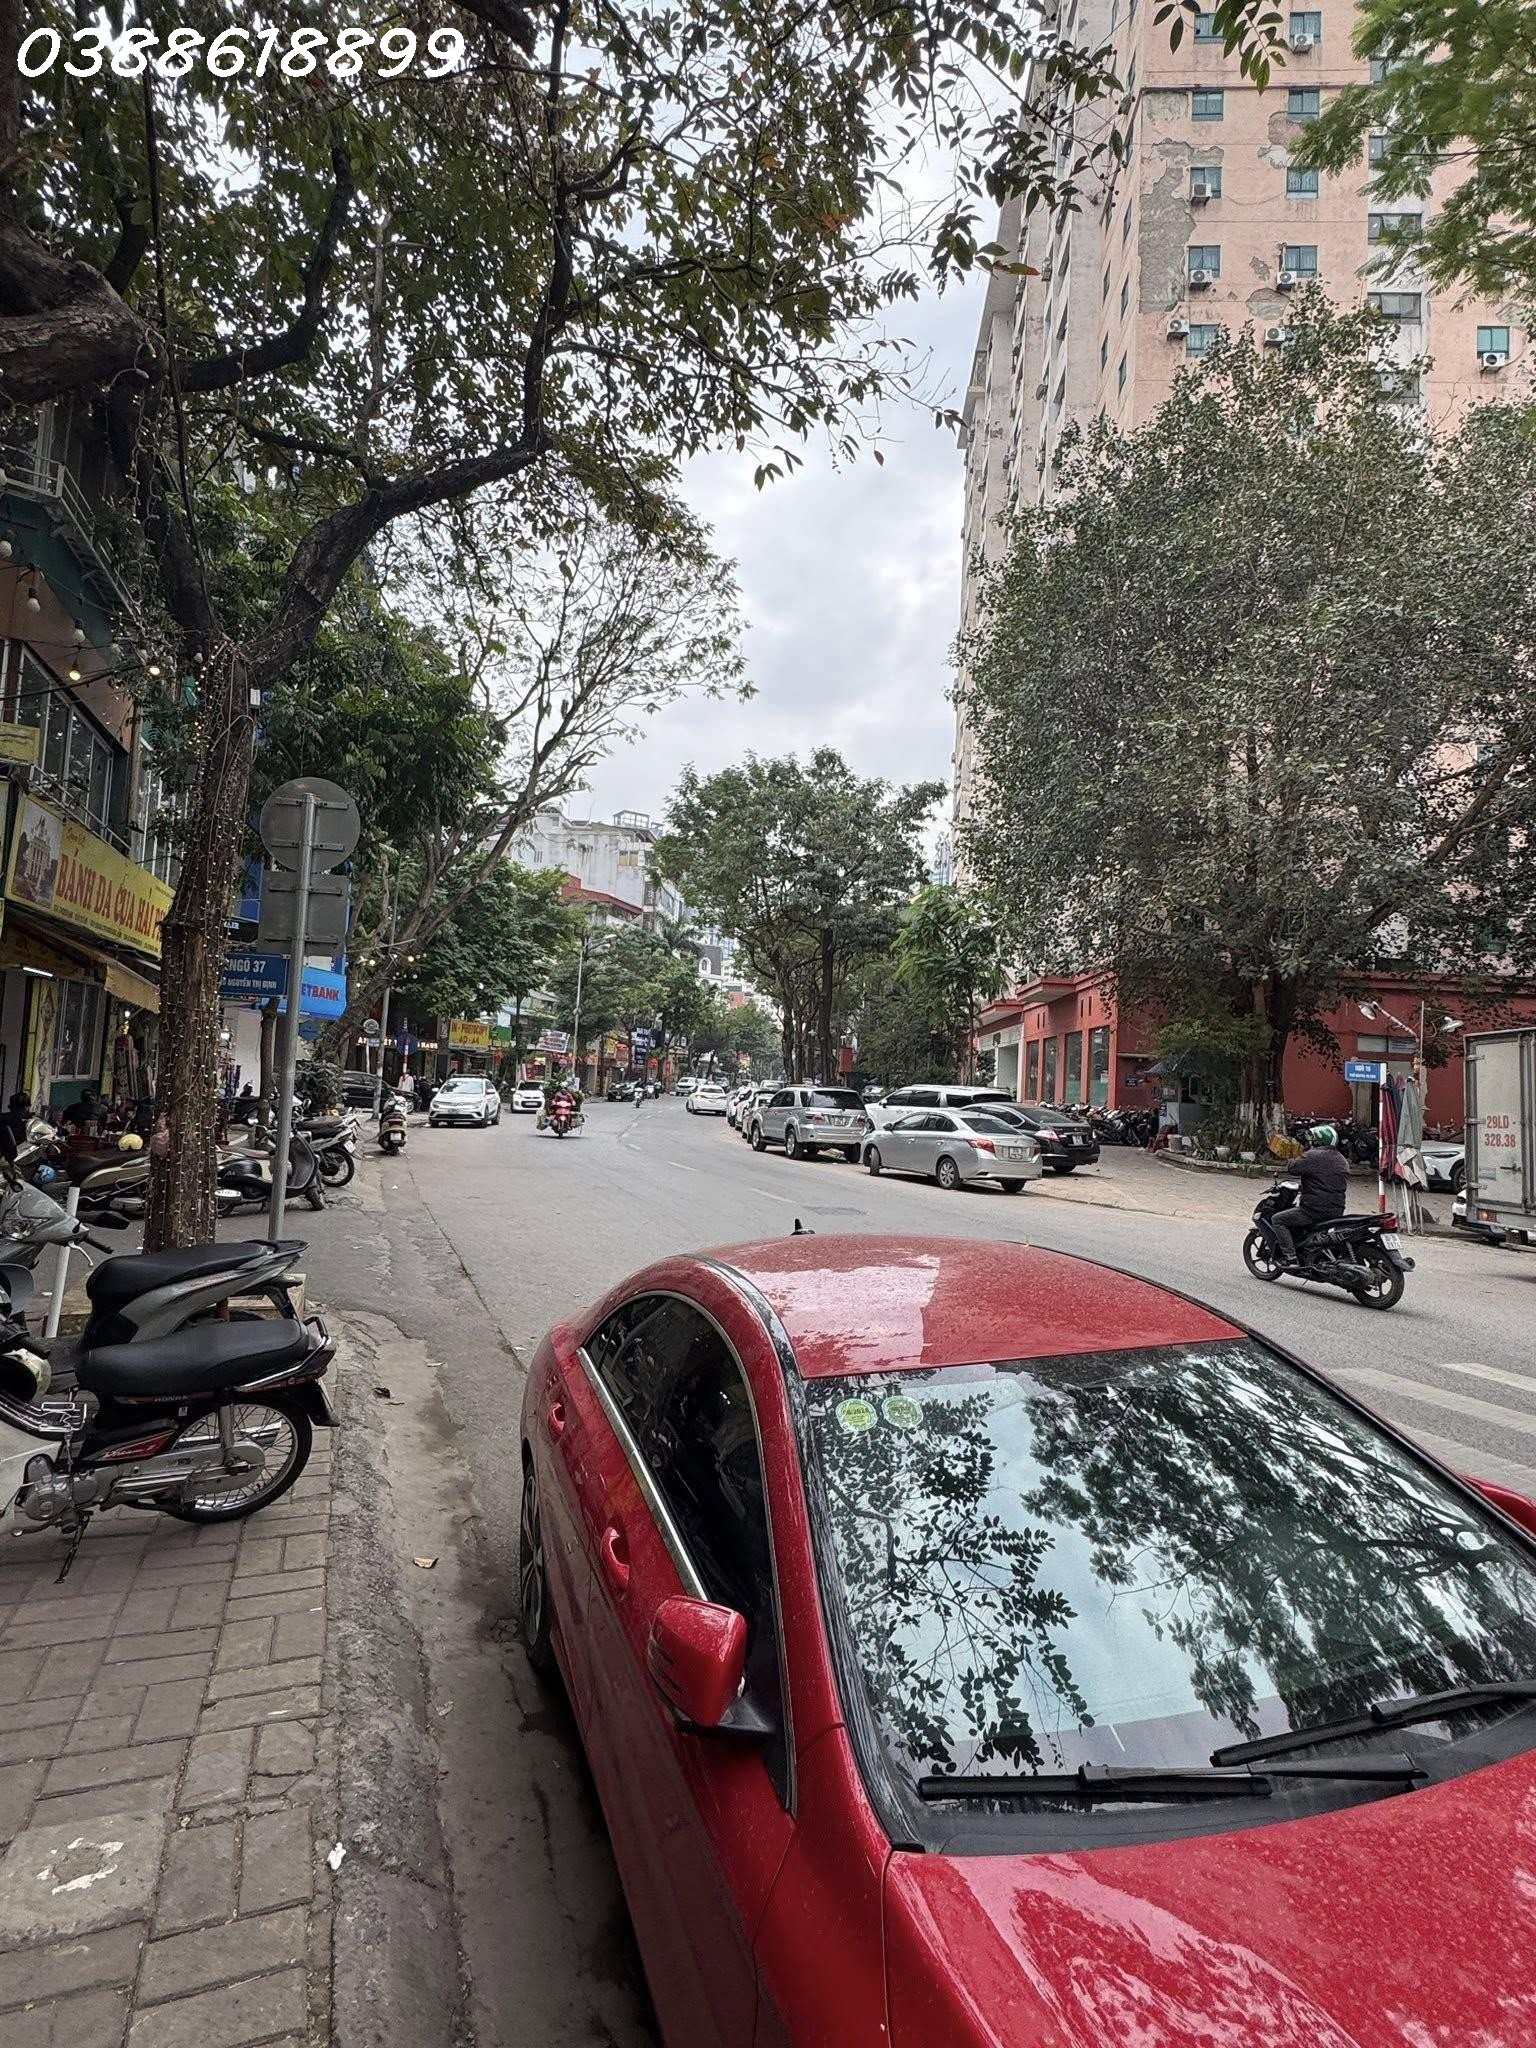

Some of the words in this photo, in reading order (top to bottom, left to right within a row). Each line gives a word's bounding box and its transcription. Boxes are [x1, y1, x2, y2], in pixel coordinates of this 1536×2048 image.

[229, 957, 251, 972] NGÕ
[253, 961, 266, 973] 37
[1486, 1115, 1510, 1129] 29LD
[1484, 1133, 1516, 1148] 328.38
